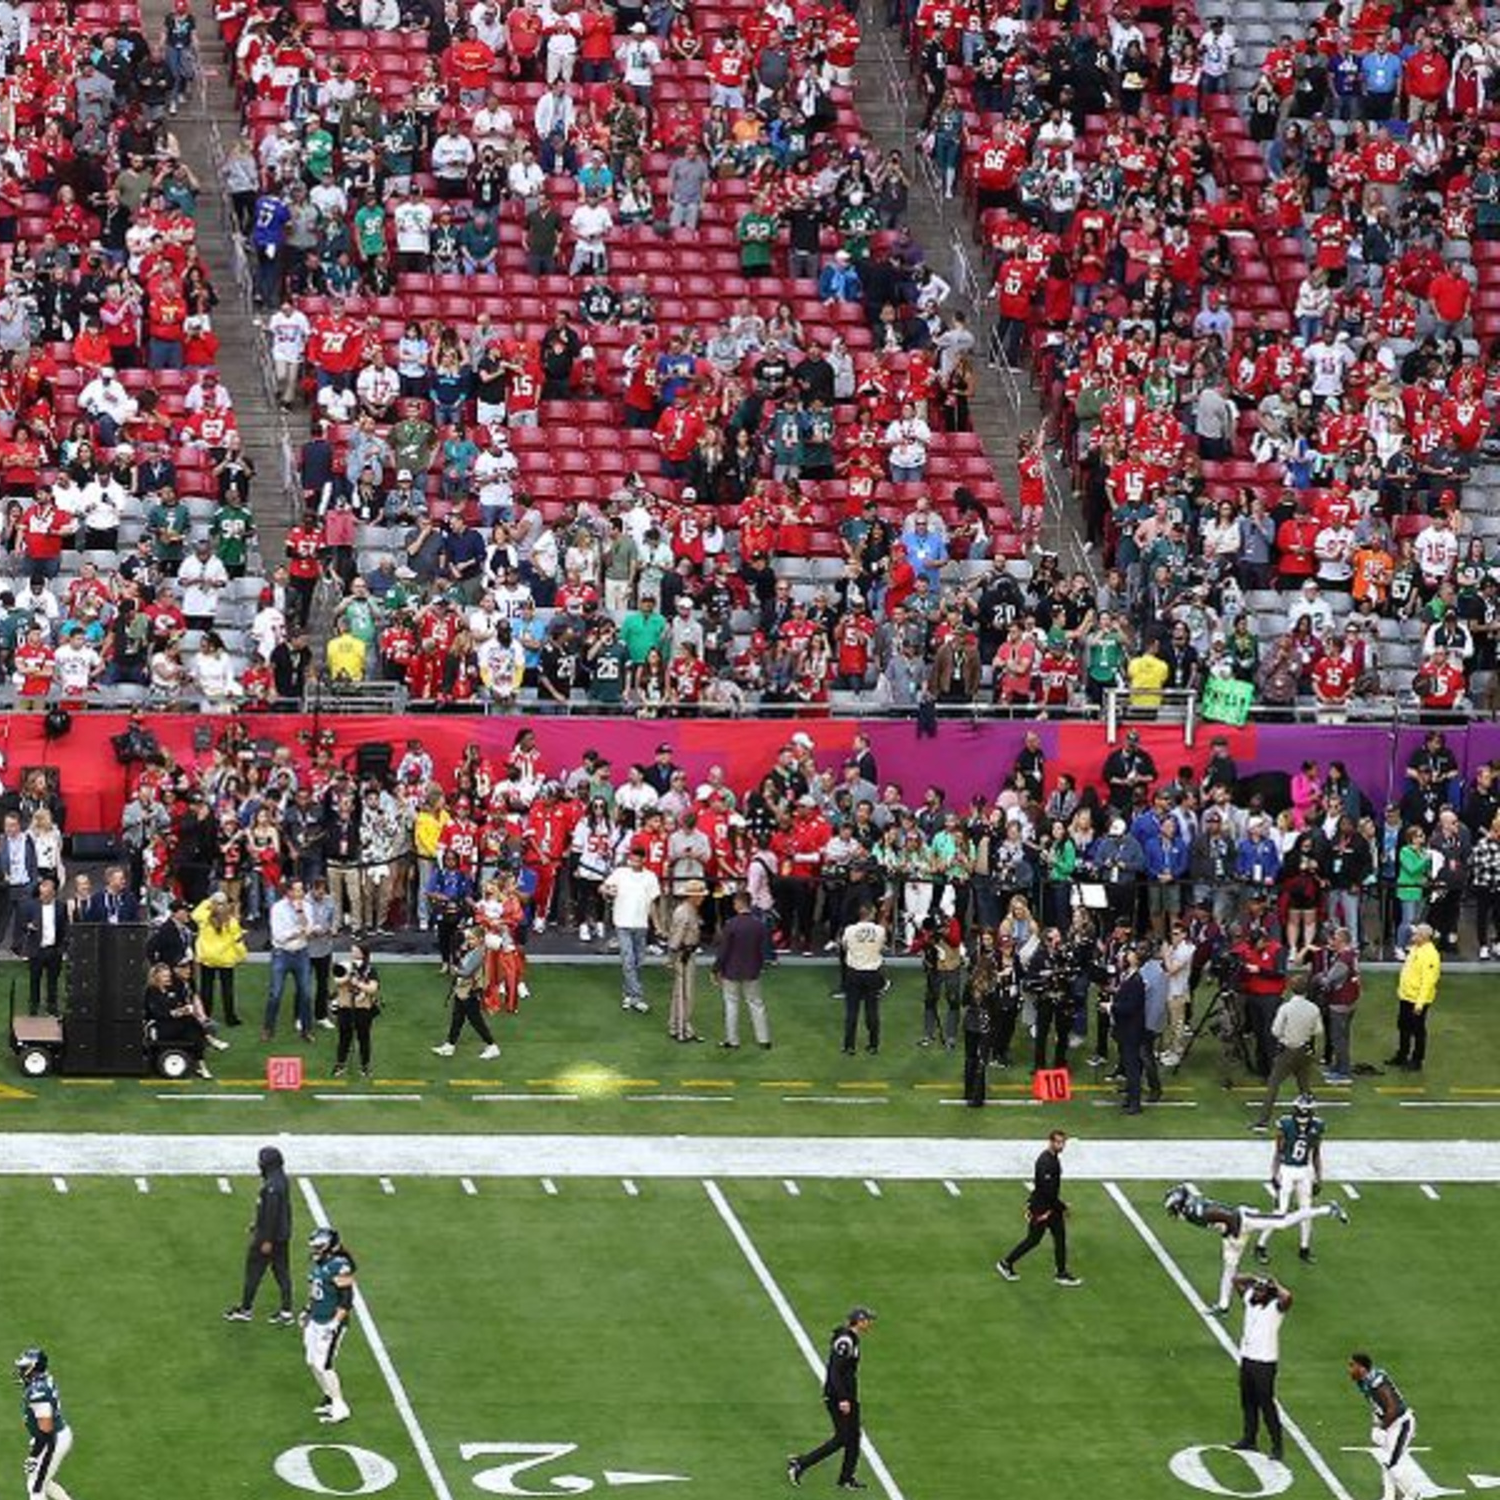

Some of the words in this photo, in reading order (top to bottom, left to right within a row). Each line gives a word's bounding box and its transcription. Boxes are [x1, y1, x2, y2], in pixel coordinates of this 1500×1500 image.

[513, 376, 534, 397] 15
[1421, 433, 1439, 454] 15
[679, 519, 699, 539] 15
[994, 605, 1017, 625] 20
[597, 657, 620, 679] 26
[543, 821, 552, 844] 1
[451, 835, 473, 855] 22
[270, 1059, 300, 1085] 20
[1046, 1072, 1066, 1099] 10
[1291, 1138, 1307, 1162] 6
